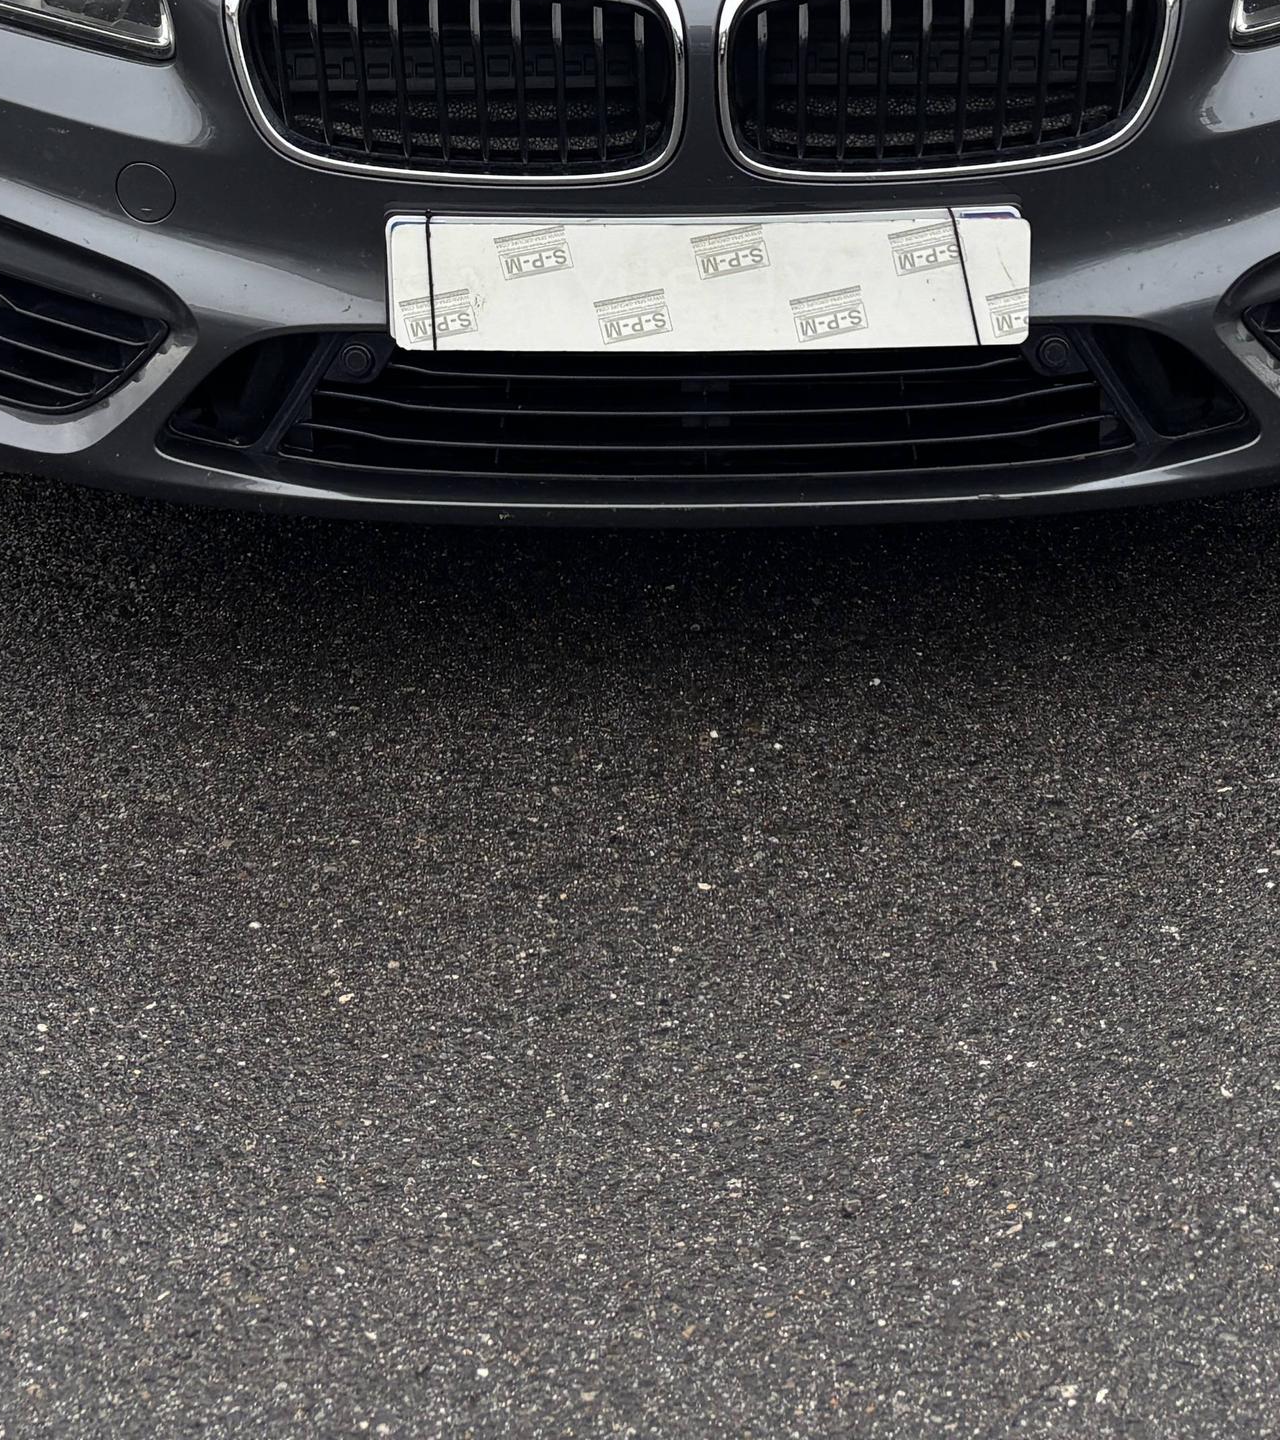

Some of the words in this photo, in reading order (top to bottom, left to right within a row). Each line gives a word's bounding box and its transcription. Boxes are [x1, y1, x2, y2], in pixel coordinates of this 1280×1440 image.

[505, 249, 567, 274] S-P-M
[701, 248, 764, 273] S-P-M
[899, 244, 960, 270] S-P-M
[604, 313, 666, 338] S-P-M
[800, 310, 862, 336] S-P-M
